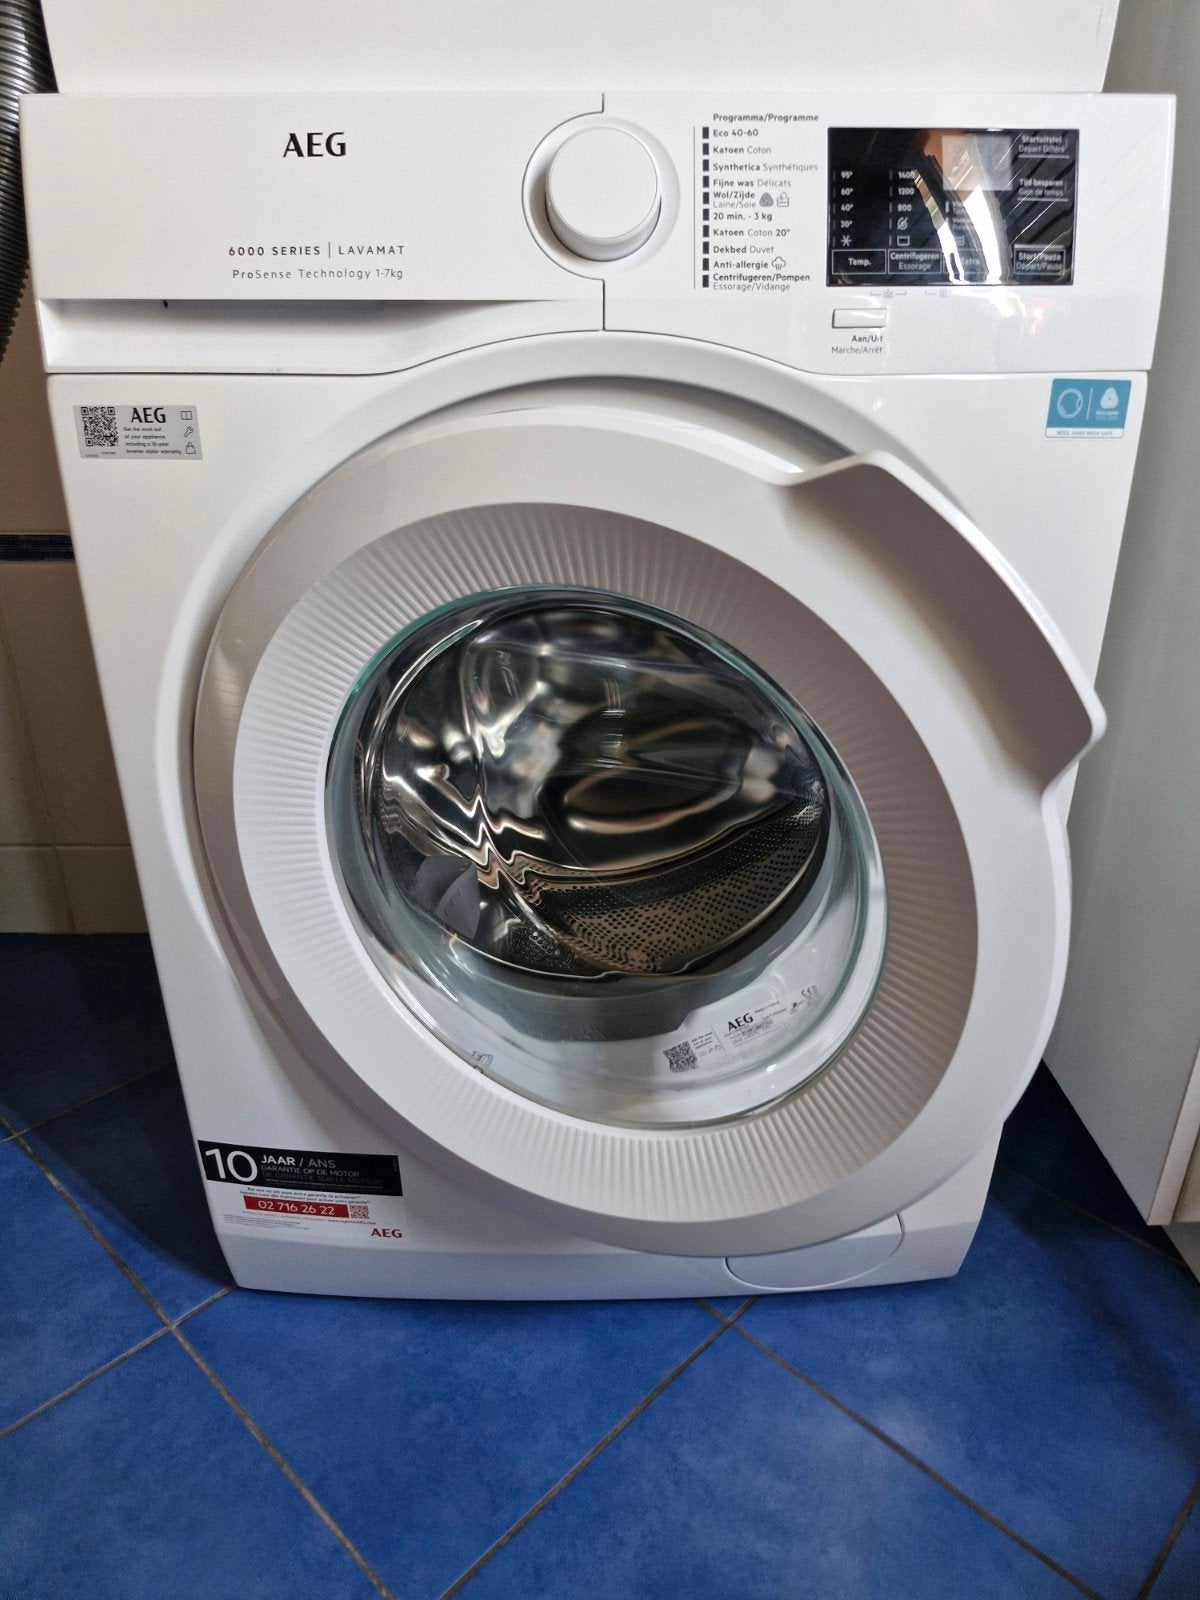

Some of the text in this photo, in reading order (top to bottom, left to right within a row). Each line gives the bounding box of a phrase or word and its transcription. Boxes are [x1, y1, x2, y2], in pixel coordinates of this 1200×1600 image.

[713, 113, 819, 123] Programma/Programme
[713, 129, 759, 137] Eco 40-60
[283, 132, 347, 158] AEG
[713, 146, 772, 154] Katoen Coton
[713, 163, 819, 172] Synthetica Synthétiques
[713, 179, 735, 188] Fijne
[757, 179, 792, 187] Délicats
[713, 191, 756, 200] Wol/Zijde
[898, 188, 915, 196] 1200
[713, 200, 757, 209] Laine/Soie
[727, 212, 746, 220] min.
[754, 212, 759, 220] 3
[761, 212, 773, 222] kg
[713, 229, 745, 237] Katoen
[747, 229, 773, 237] Coton
[228, 245, 321, 257] 6000 SERIES
[338, 245, 405, 256] LAVAMAT
[749, 246, 774, 254] Duvet
[848, 257, 872, 267] Temp.
[890, 252, 940, 262] Centrifugeren
[713, 261, 769, 270] Anti-allergie
[232, 268, 403, 280] ProSense Technology 1-7kg
[713, 273, 811, 283] Centrifugeren/Pompen
[713, 282, 791, 292] Essorage/Vidange
[831, 346, 883, 355] Marche/Arrêt
[131, 407, 167, 424] AEG
[727, 1013, 754, 1032] AEG
[205, 1148, 258, 1183] 10
[260, 1154, 336, 1169] JAAR / ANS
[261, 1165, 301, 1174] GARANTIE
[329, 1170, 360, 1178] MOTOR
[257, 1199, 335, 1216] 02 716 26 22
[371, 1227, 403, 1239] AEG
